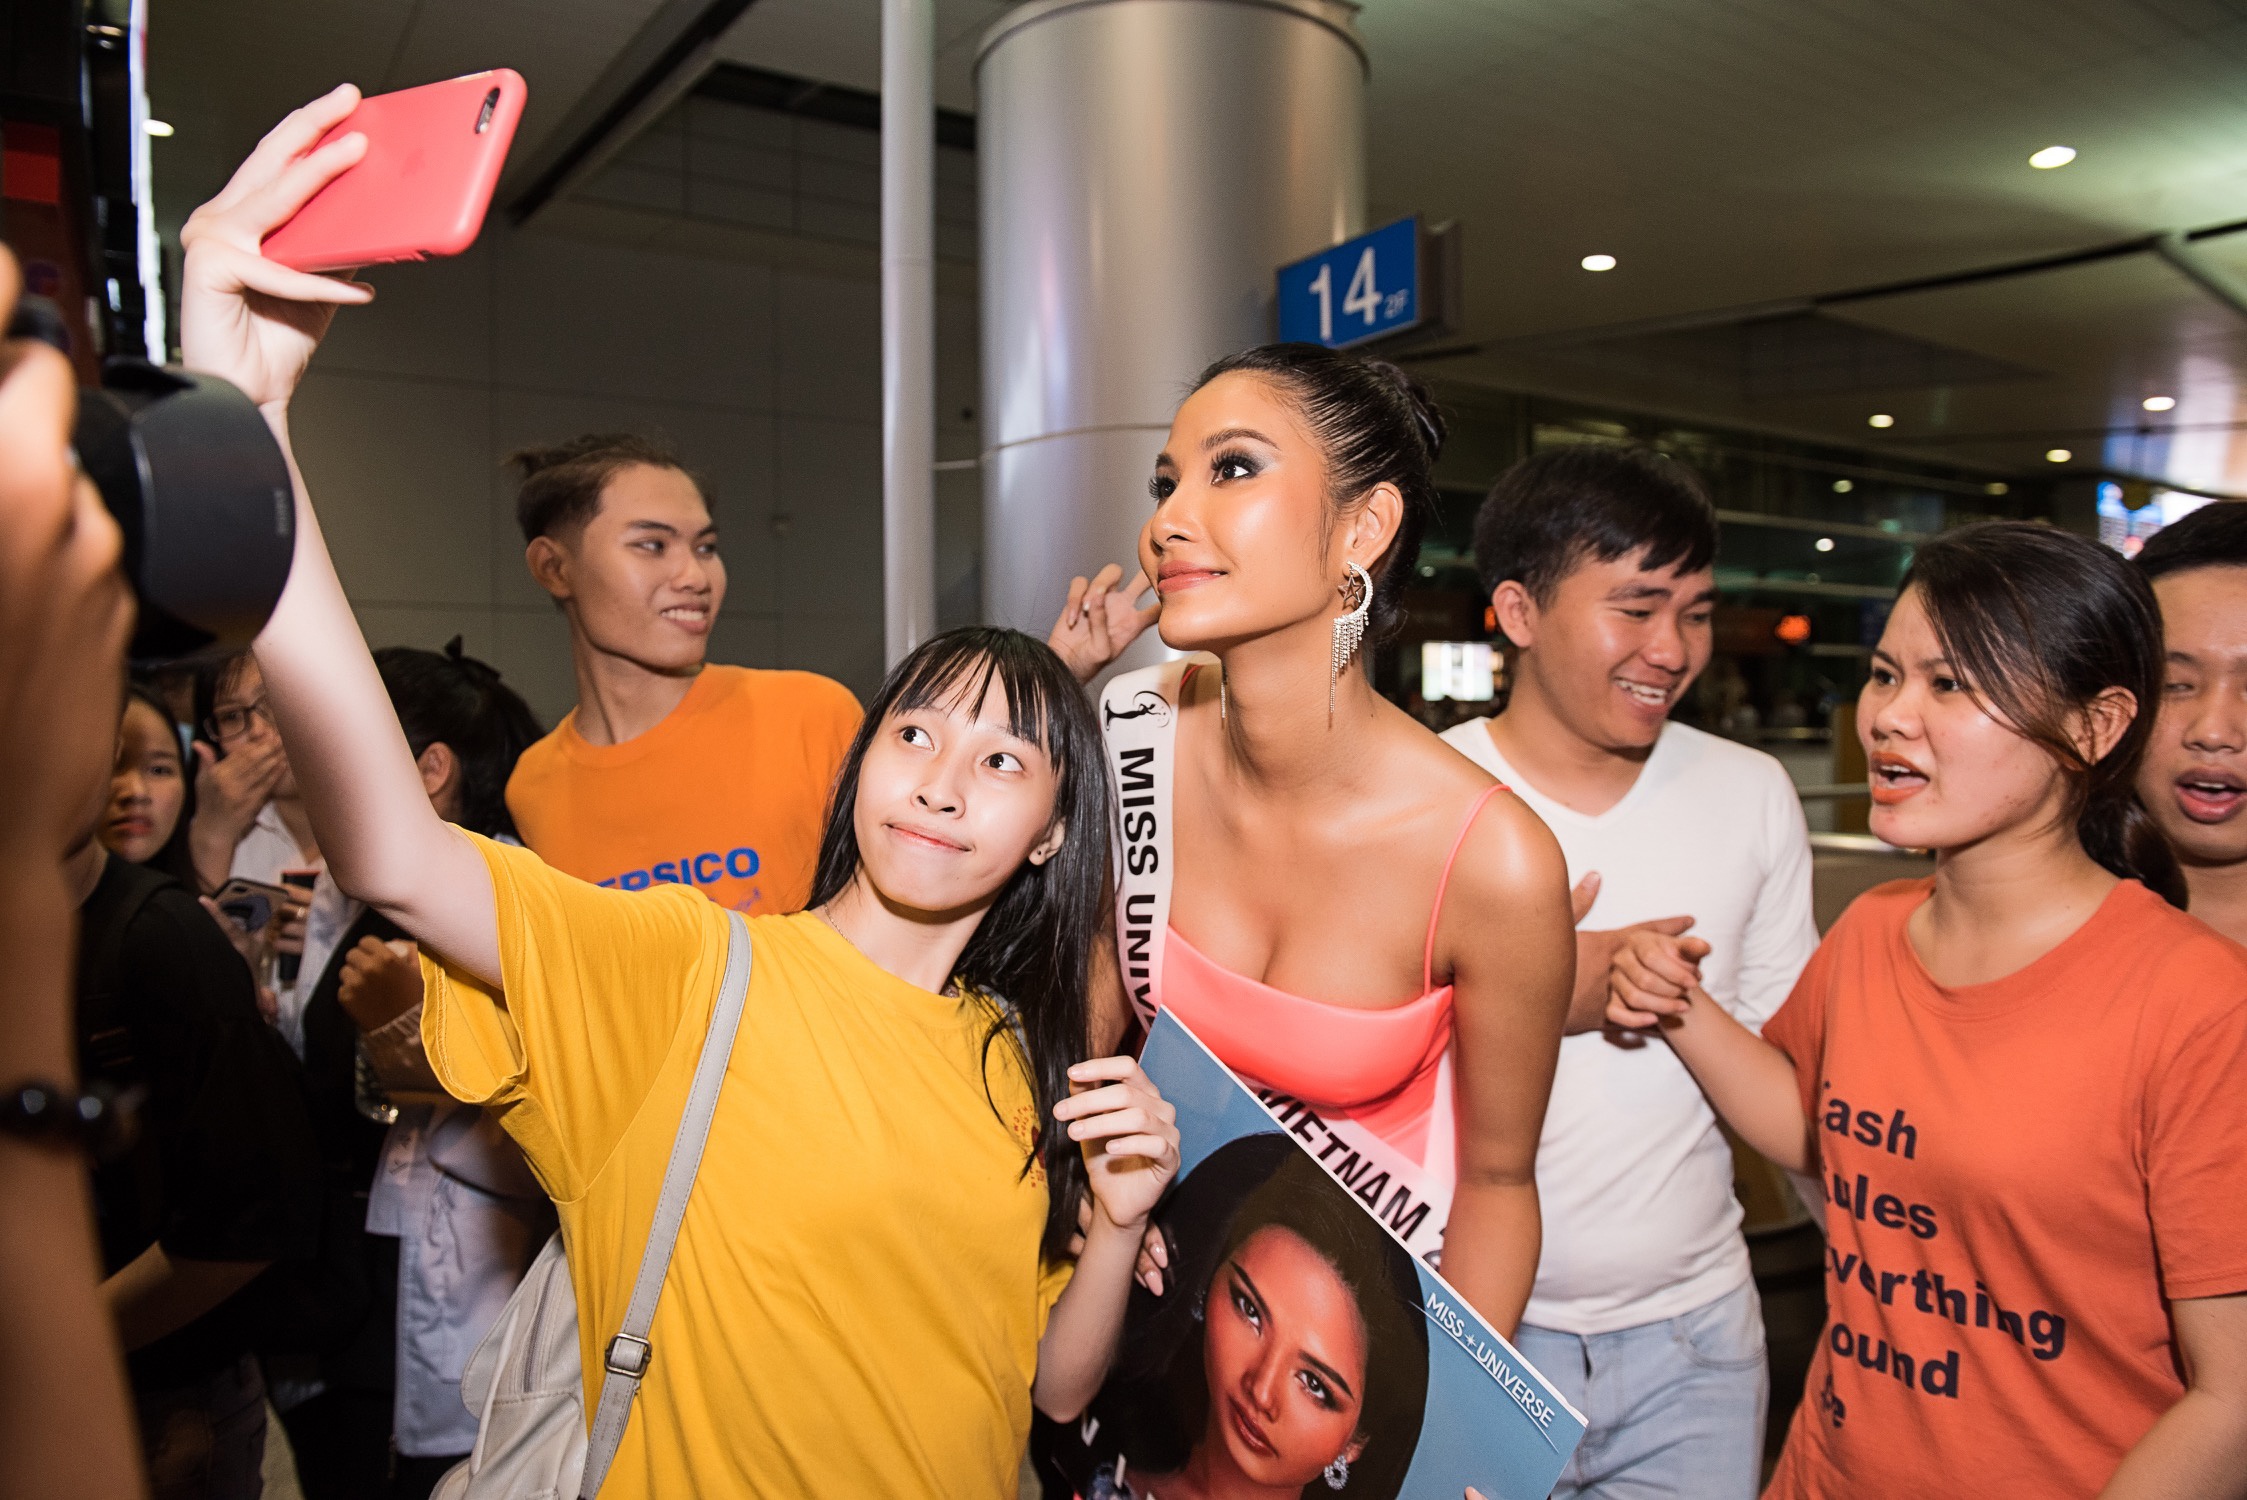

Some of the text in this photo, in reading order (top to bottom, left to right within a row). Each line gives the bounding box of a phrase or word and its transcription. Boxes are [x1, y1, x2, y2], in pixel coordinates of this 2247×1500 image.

[1308, 246, 1384, 341] 14
[595, 847, 760, 892] PSICO
[1119, 747, 1159, 1028] MISS UNIV
[1823, 1083, 1918, 1160] ash
[1823, 1168, 1939, 1240] ules
[1826, 1245, 2067, 1362] verthing
[1425, 1292, 1556, 1429] MISS UNIVERSE
[1830, 1322, 1960, 1400] ound
